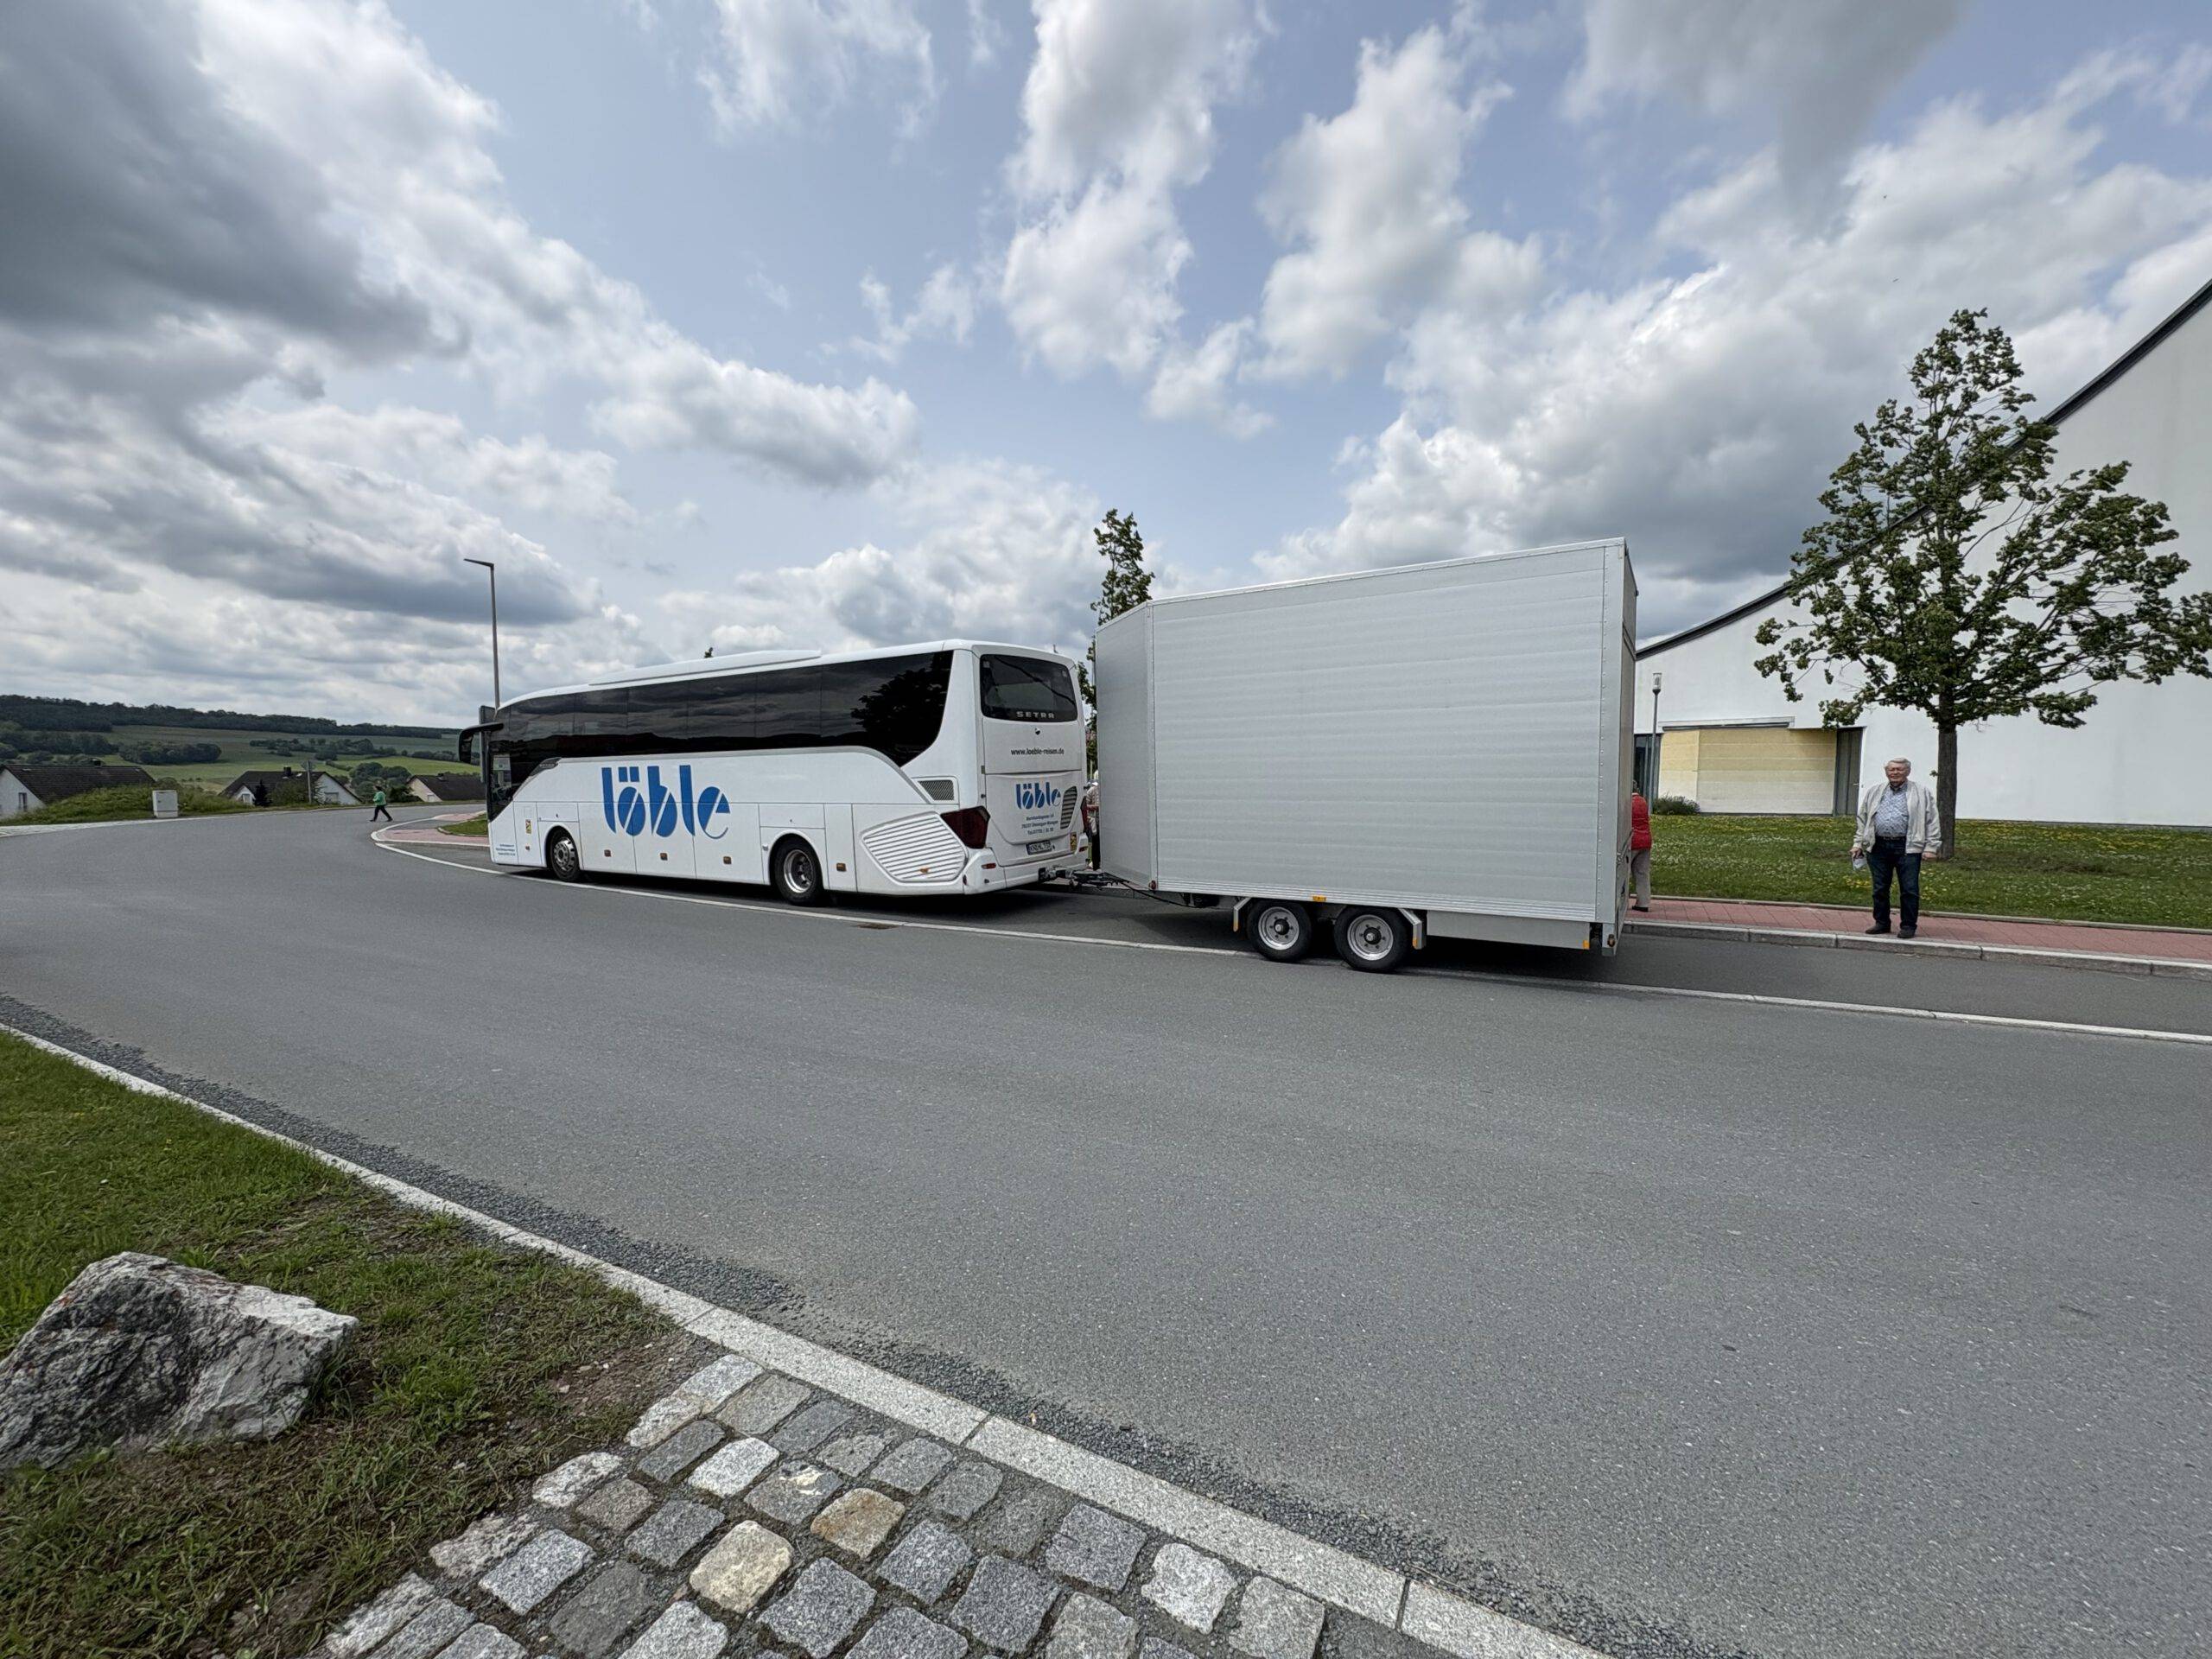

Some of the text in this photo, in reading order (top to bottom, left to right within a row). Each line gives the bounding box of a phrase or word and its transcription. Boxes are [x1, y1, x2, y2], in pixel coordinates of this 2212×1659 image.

[1016, 710, 1055, 719] SETRA
[601, 765, 730, 839] löble
[1015, 781, 1061, 810] löble
